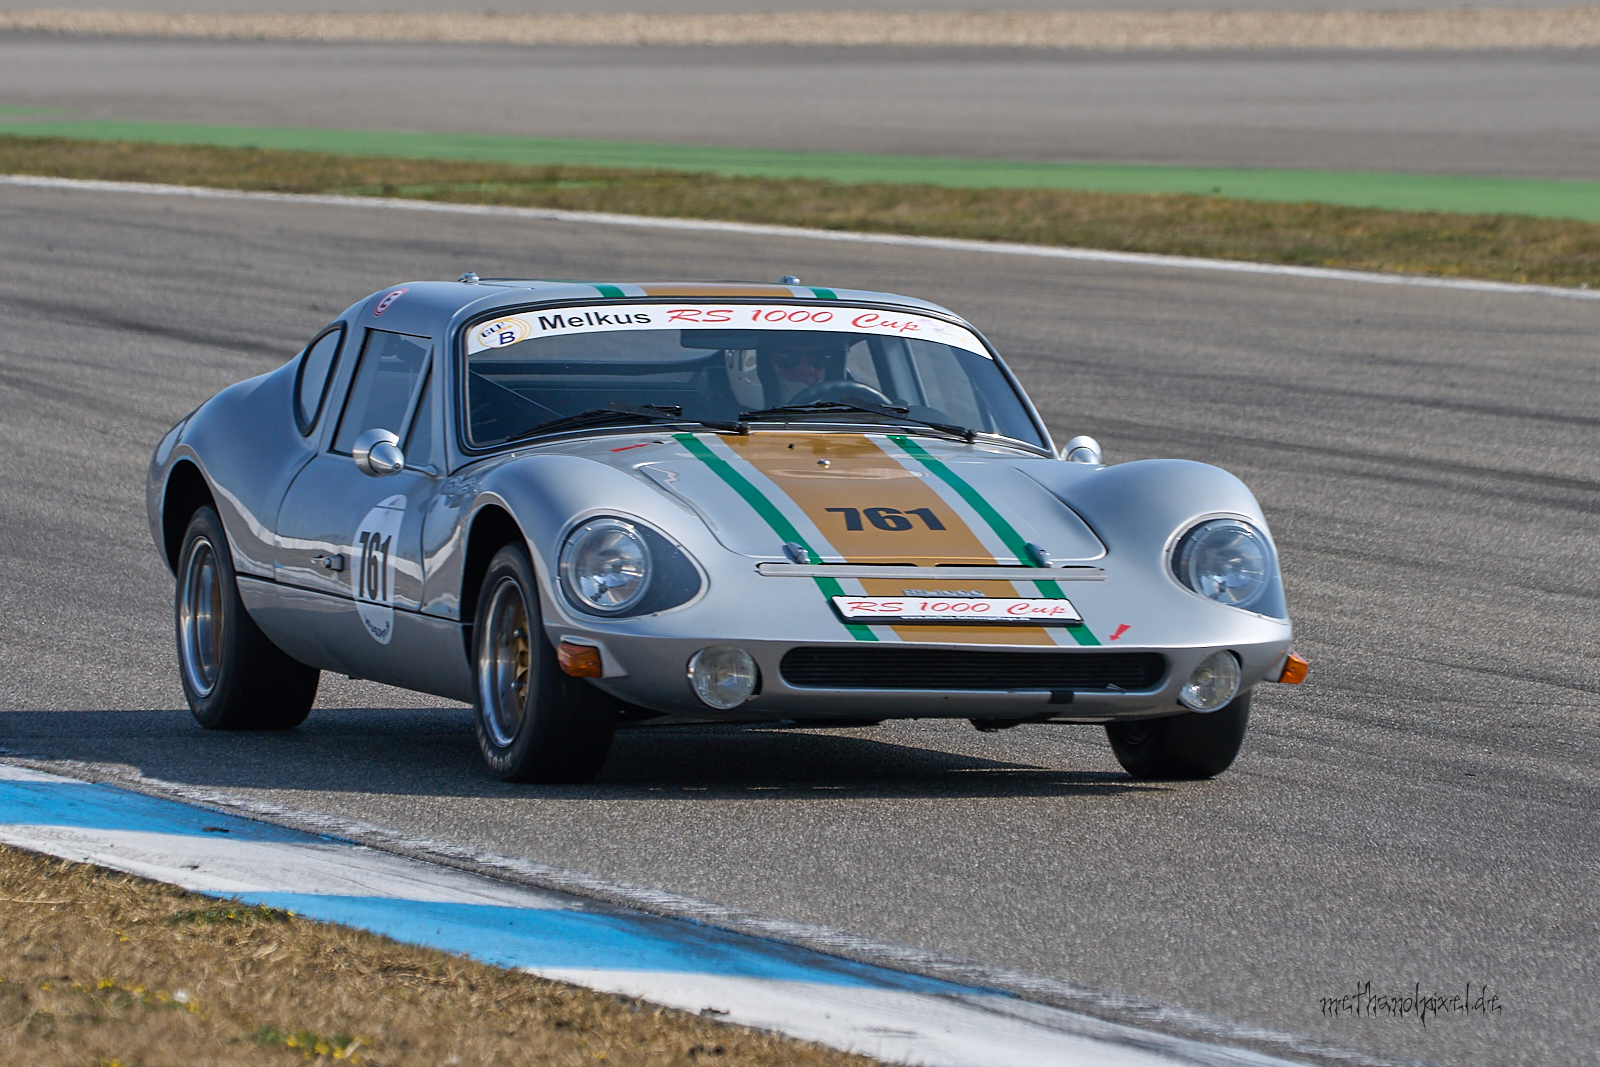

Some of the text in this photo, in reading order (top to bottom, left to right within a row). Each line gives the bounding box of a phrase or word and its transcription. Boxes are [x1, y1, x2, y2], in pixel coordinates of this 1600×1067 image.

[481, 321, 505, 338] GLP
[538, 310, 652, 332] Melkus
[667, 308, 734, 324] RS
[751, 308, 834, 324] 1000
[851, 312, 922, 333] Cup
[499, 331, 516, 345] B
[824, 507, 947, 532] 761
[358, 531, 392, 602] 761
[846, 600, 1069, 616] RS 1000 Cup
